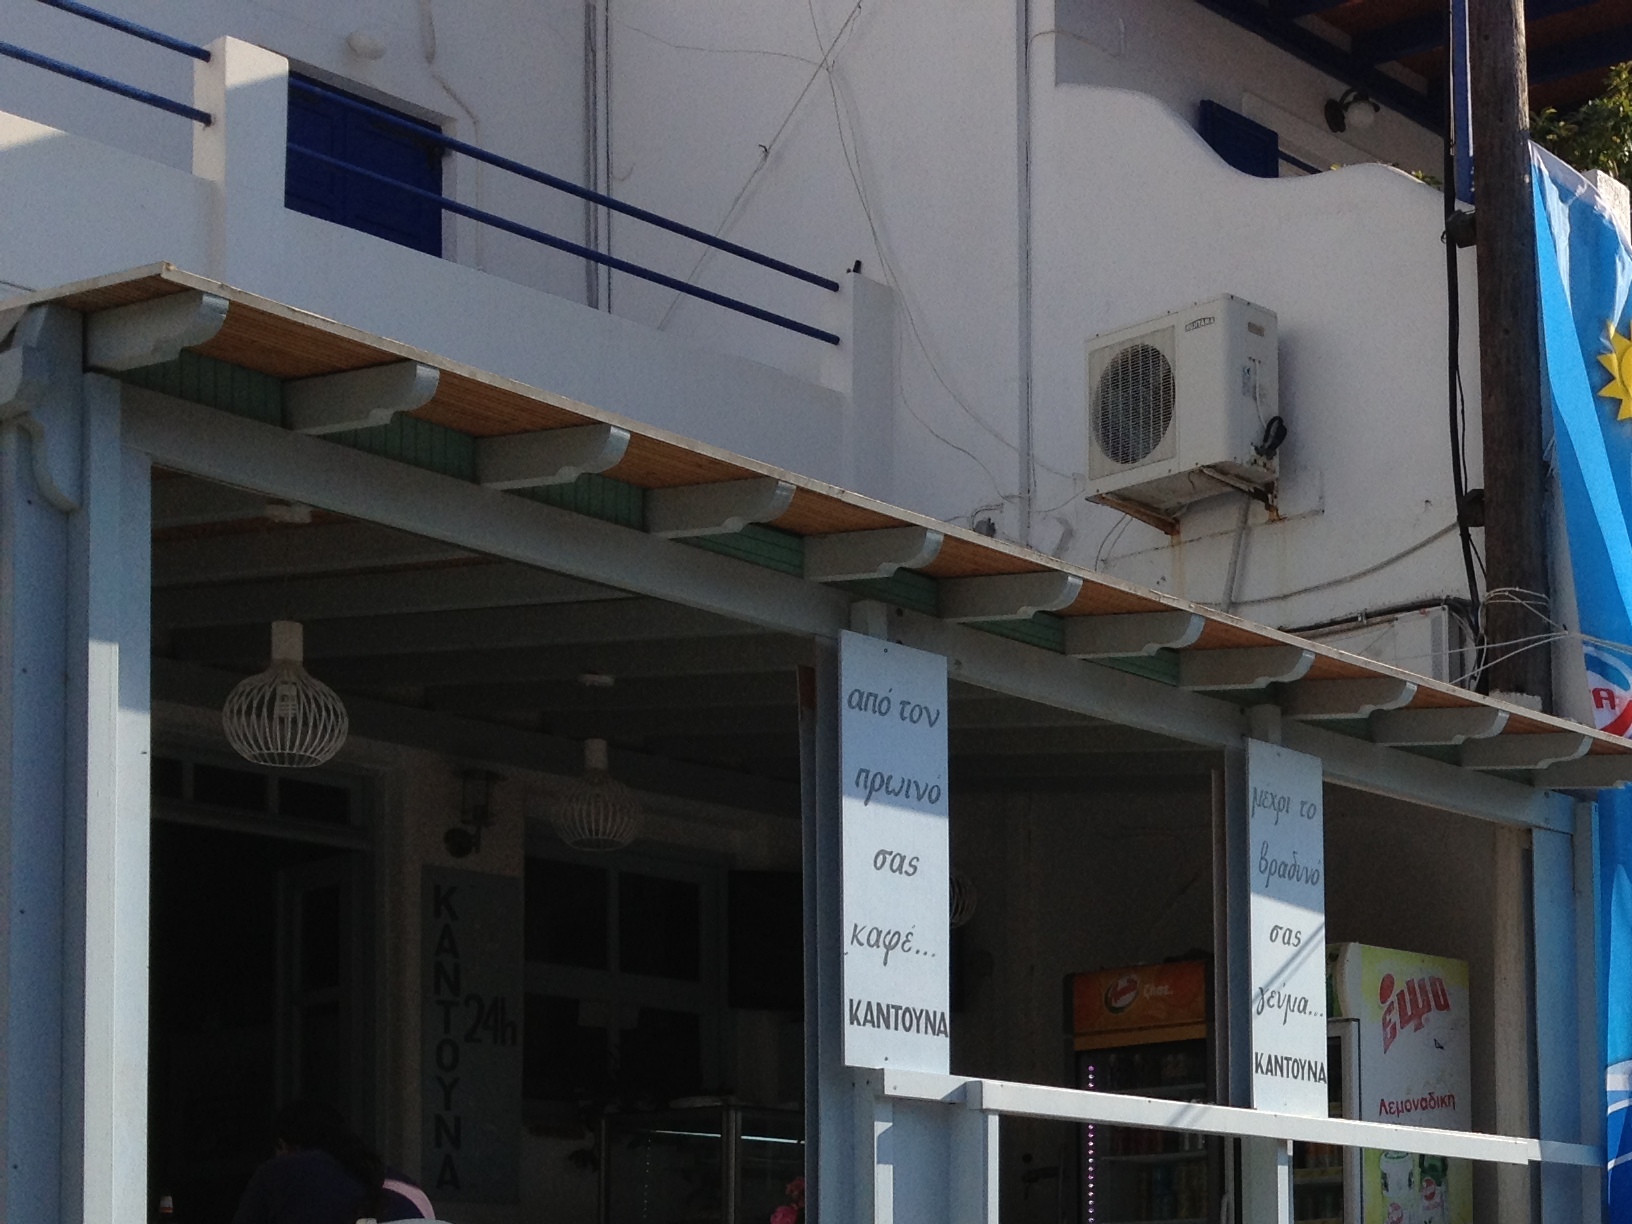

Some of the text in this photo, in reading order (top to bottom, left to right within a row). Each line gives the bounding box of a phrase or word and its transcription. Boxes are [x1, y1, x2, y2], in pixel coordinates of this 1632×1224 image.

[847, 687, 941, 729] από τον
[854, 766, 942, 806] πρωινό
[1300, 800, 1318, 821] το
[873, 847, 919, 877] σας
[1269, 923, 1302, 949] σας
[463, 992, 518, 1046] 24h
[848, 998, 949, 1039] ΚΑΝΤΟΥΝΑ
[1254, 1051, 1327, 1085] ΚΑΝΤΟΥΝΑ
